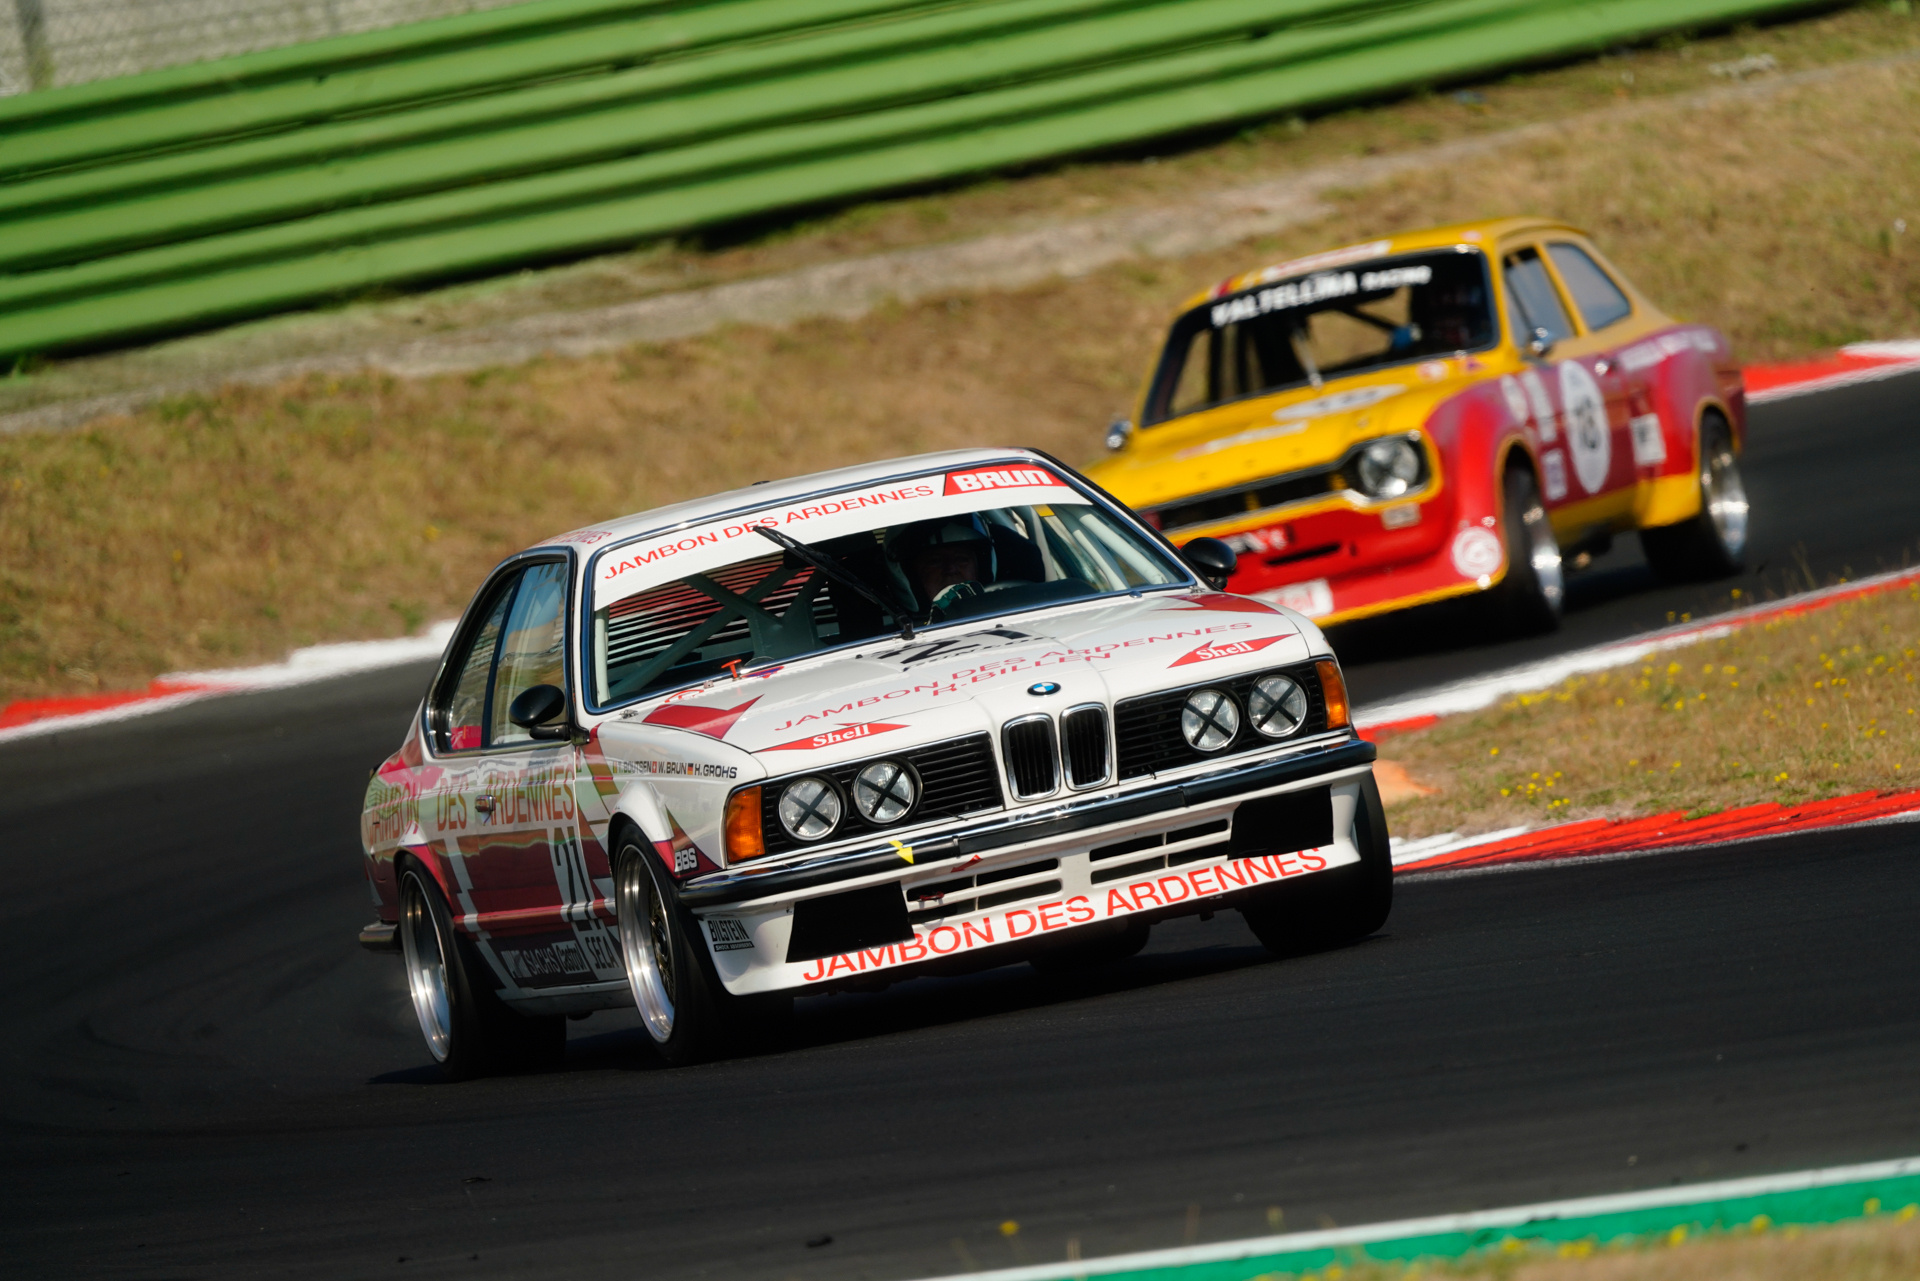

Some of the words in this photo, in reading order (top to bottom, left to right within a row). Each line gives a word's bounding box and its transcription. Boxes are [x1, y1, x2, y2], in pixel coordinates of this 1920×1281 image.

[951, 470, 1053, 492] BRUN
[604, 532, 719, 580] JAMBON
[722, 516, 779, 539] DES
[785, 485, 935, 524] ARDENNES
[1196, 641, 1255, 661] Shell
[774, 681, 939, 731] JAMBON
[952, 656, 1027, 680] DES
[1041, 622, 1253, 660] ARDENNES
[812, 723, 870, 748] Shell
[658, 761, 687, 775] W.BRUN
[694, 763, 738, 779] H.GROHS
[437, 774, 468, 832] DES
[485, 763, 576, 827] ARDENNES
[674, 847, 698, 873] BBS
[803, 917, 995, 982] JAMBON
[1005, 895, 1096, 939] DES
[1107, 848, 1327, 917] ARDENNES
[707, 919, 750, 942] BILSTEIN
[522, 947, 562, 976] SACHS
[555, 943, 588, 972] Castrol
